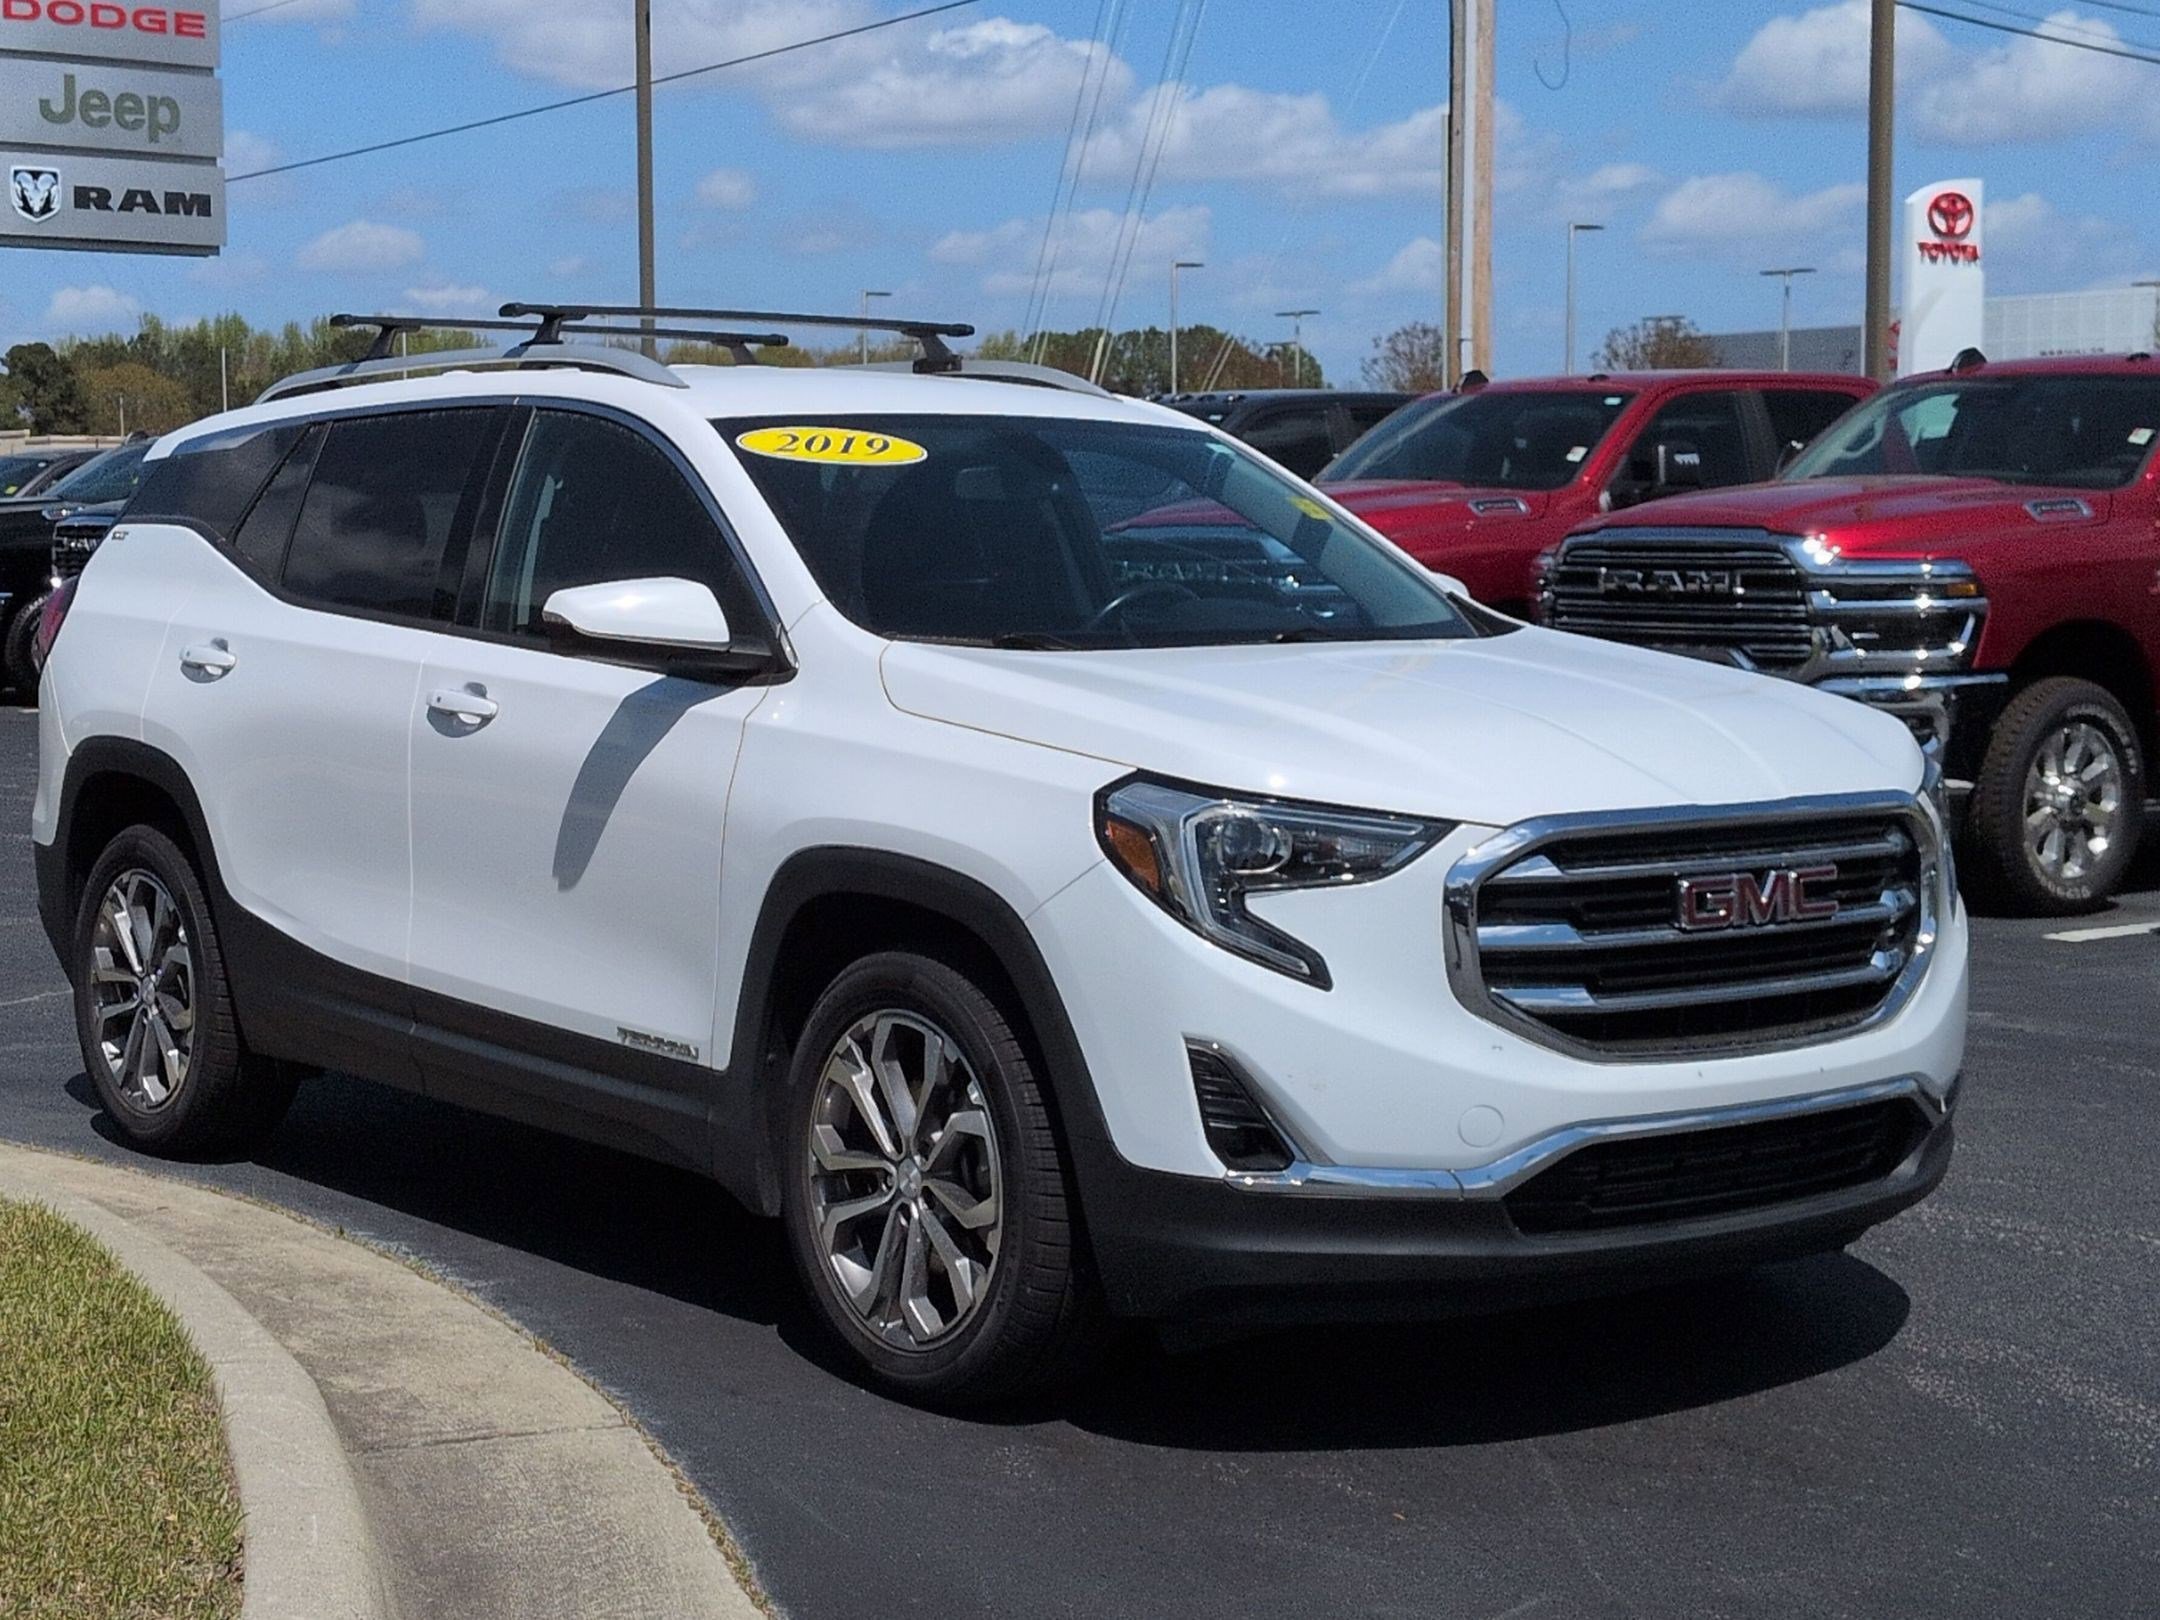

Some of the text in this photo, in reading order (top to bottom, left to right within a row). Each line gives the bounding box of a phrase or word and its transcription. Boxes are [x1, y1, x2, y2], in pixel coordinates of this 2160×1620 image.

[2, 0, 206, 38] DODGE
[38, 73, 181, 144] Jeep
[73, 185, 212, 217] RAM
[1917, 241, 1979, 263] TOYOTA
[776, 433, 890, 456] 2019
[1602, 569, 1730, 593] RAM
[1679, 864, 1839, 931] GMC
